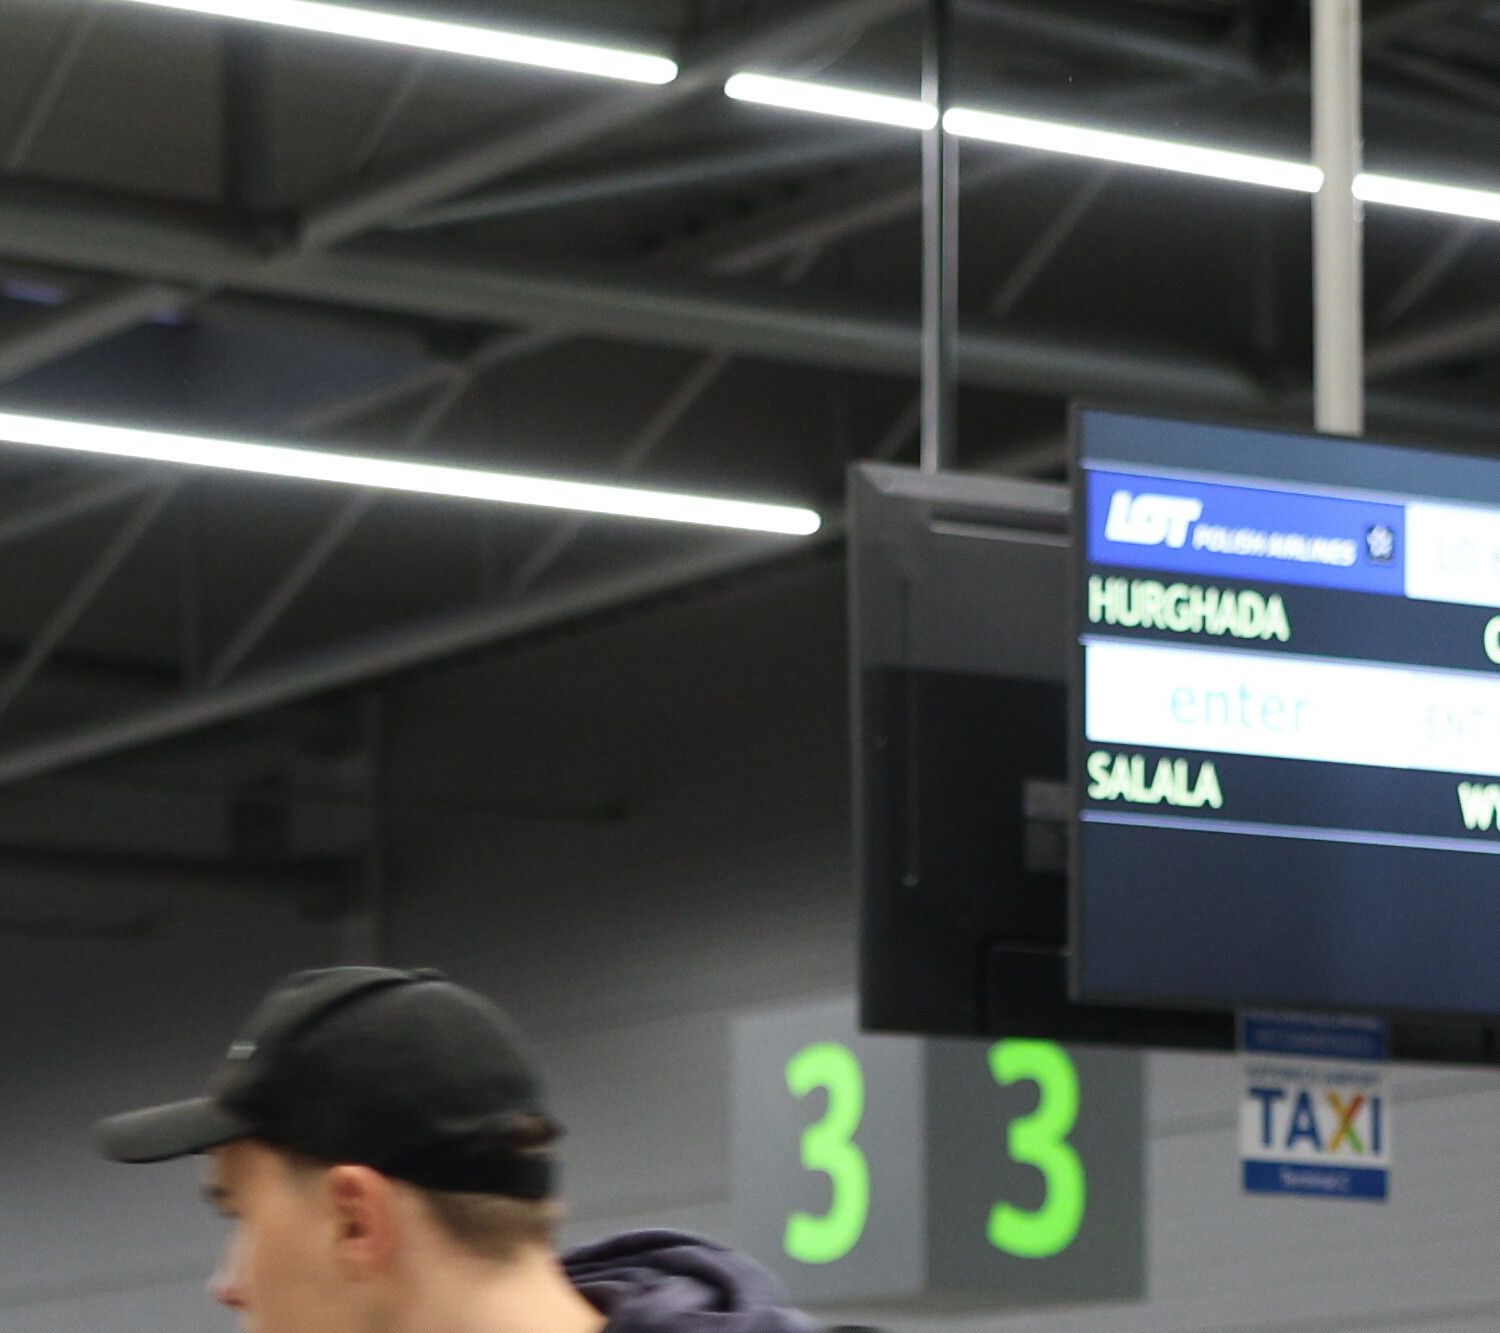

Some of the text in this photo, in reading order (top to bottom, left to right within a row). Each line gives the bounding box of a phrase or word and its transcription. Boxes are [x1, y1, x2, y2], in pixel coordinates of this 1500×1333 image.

[1105, 490, 1203, 548] LOT
[1088, 575, 1290, 643] HURGHADA
[1169, 683, 1312, 732] enter
[1087, 750, 1223, 810] SALALA
[784, 1041, 872, 1265] 3
[987, 1037, 1088, 1259] 3
[1249, 1086, 1382, 1154] TAXI
